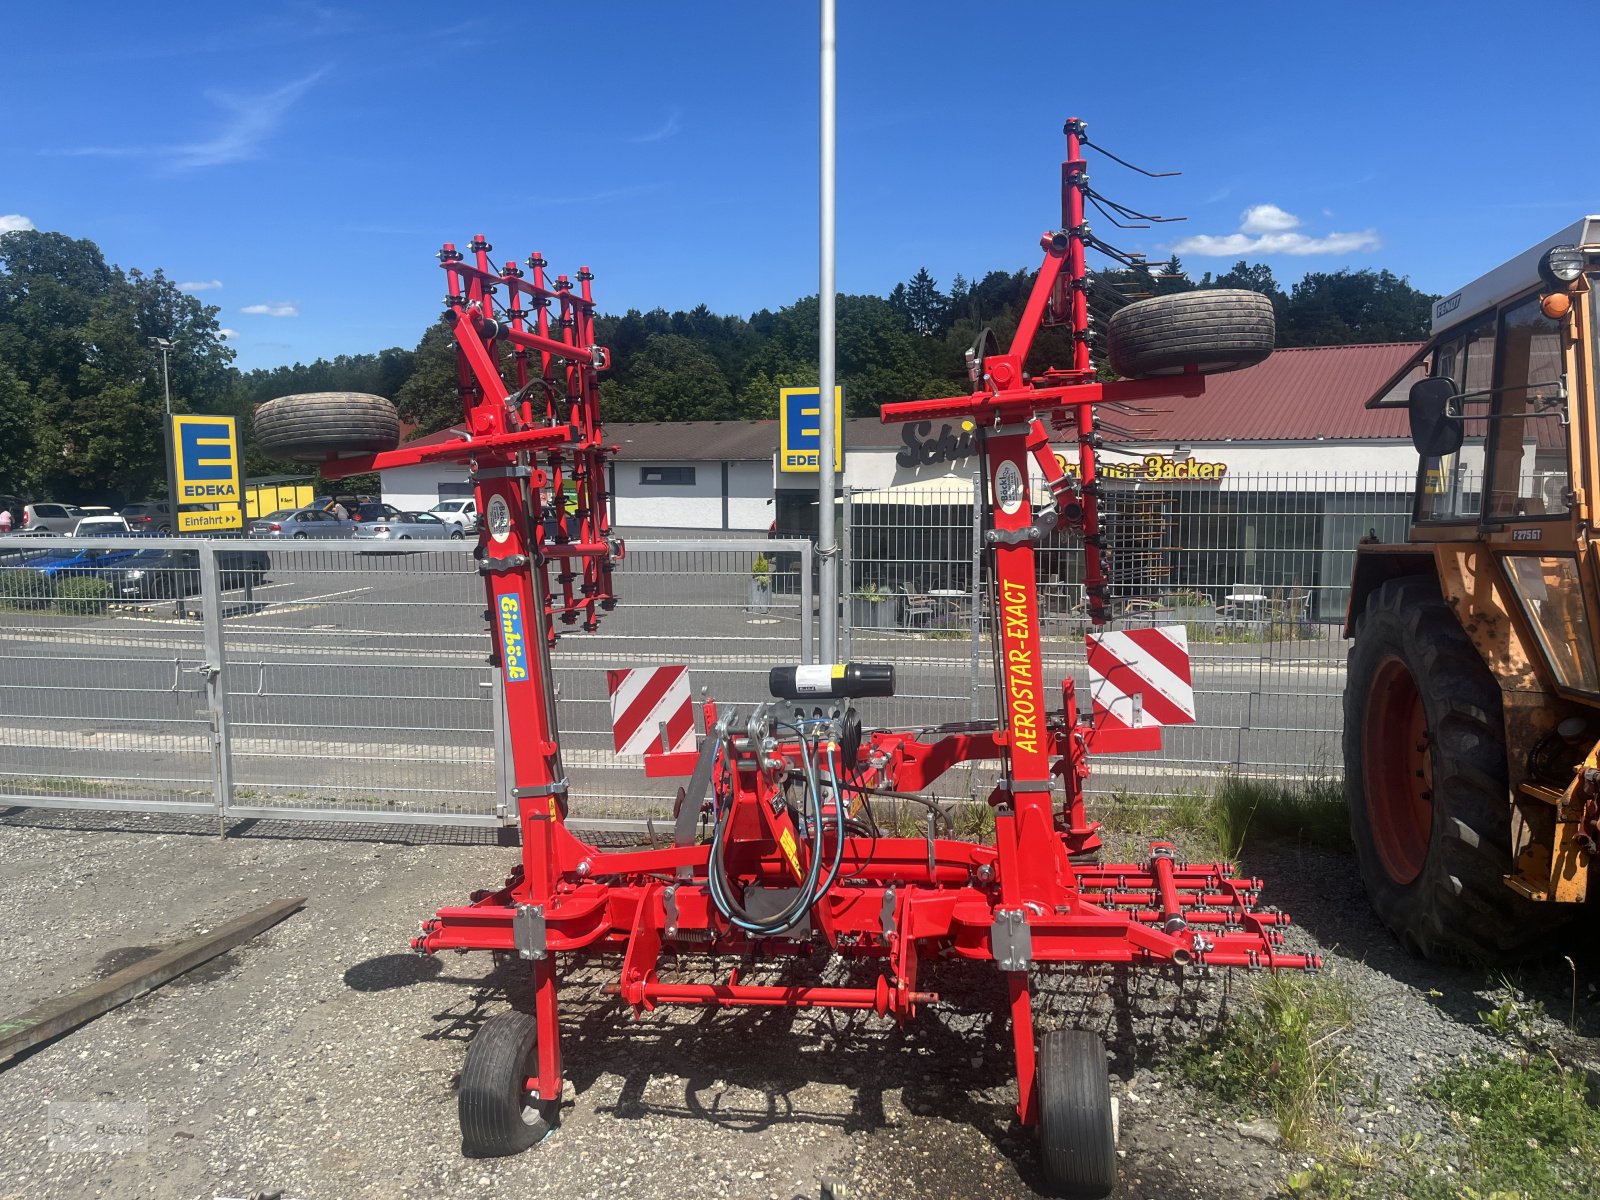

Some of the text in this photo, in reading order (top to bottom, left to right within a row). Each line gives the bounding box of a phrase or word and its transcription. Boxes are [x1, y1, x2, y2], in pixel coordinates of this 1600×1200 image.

[1144, 454, 1227, 481] Bäcker
[184, 485, 235, 496] EDEKA
[185, 516, 223, 527] Einfahrt
[501, 596, 526, 681] Einböck
[1003, 579, 1039, 754] AEROSTAR-EXACT
